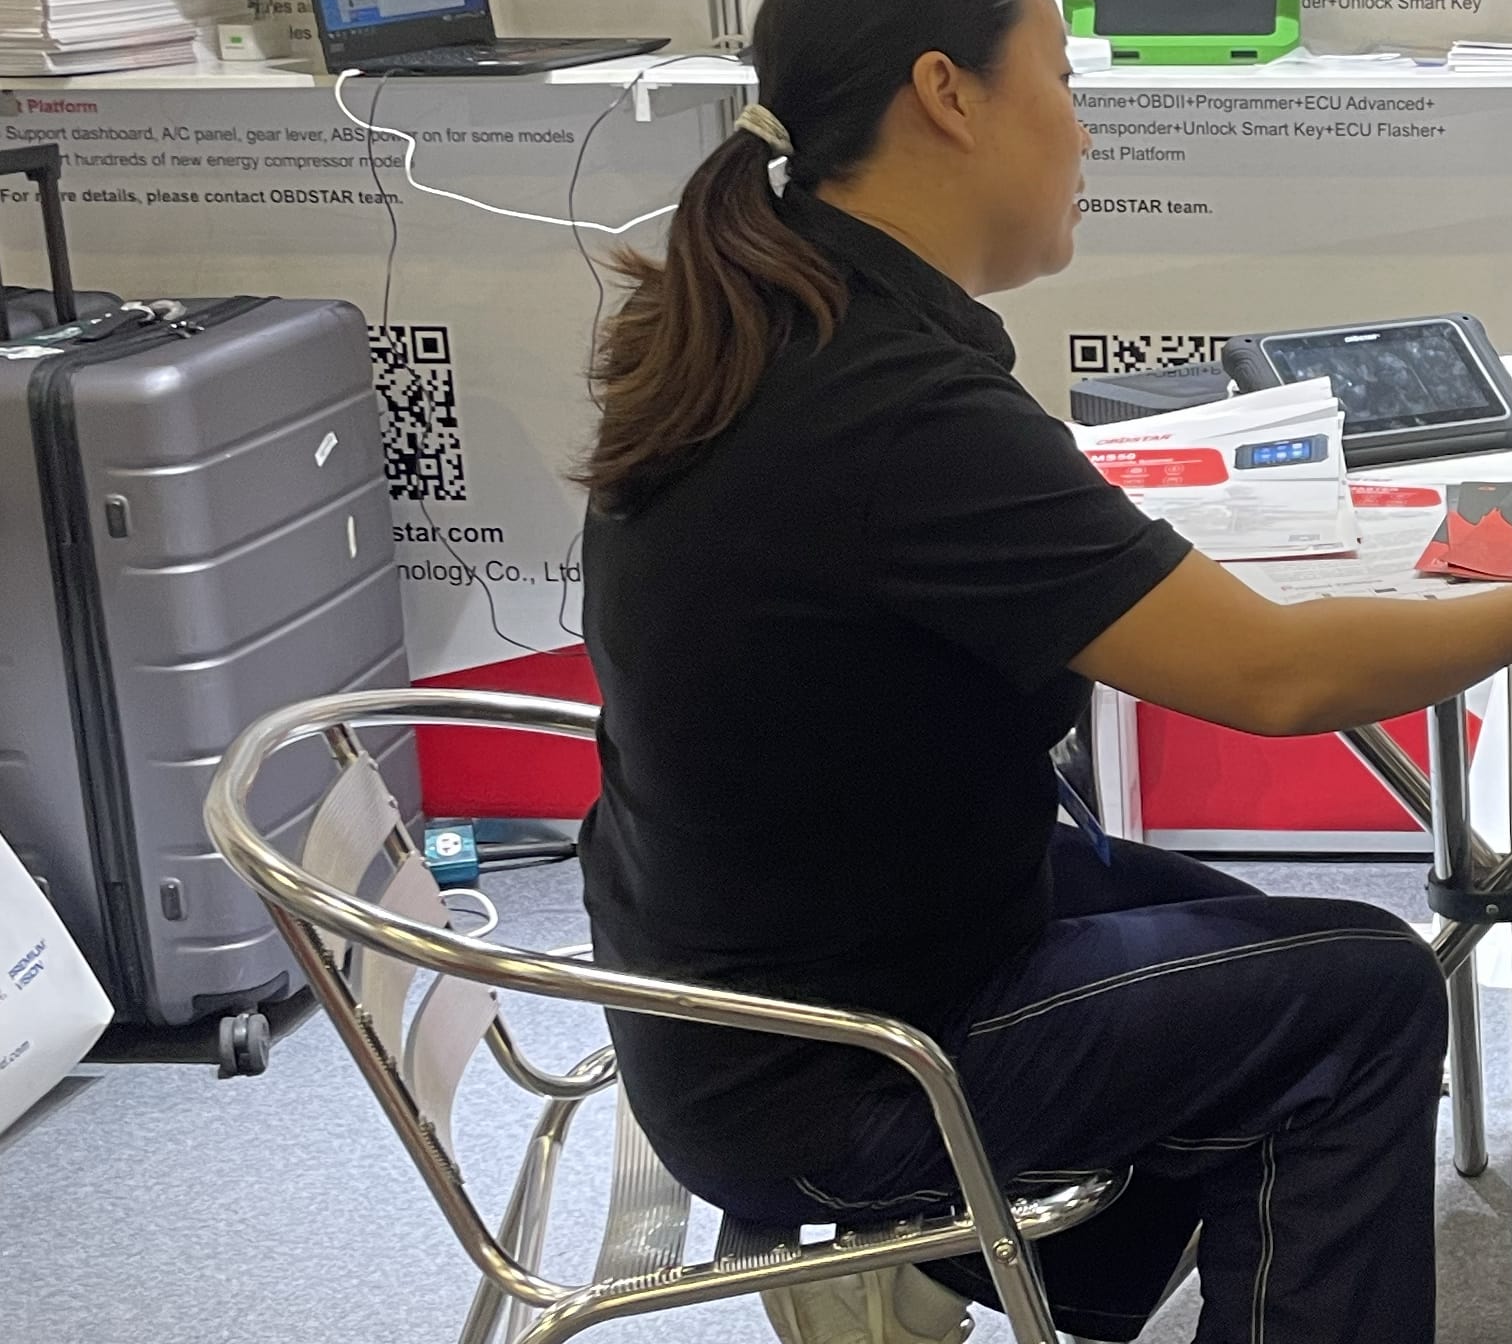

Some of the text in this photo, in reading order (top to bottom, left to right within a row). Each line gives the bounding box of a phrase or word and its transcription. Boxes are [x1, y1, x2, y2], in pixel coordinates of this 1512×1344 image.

[1344, 92, 1436, 112] Advanced+
[5, 124, 68, 145] Support
[70, 124, 158, 145] dashboard,
[161, 124, 191, 142] A/C
[193, 124, 242, 145] panel,
[245, 128, 282, 145] gear
[284, 125, 328, 145] lever,
[330, 125, 367, 142] ABS
[421, 129, 443, 143] on
[445, 125, 468, 143] for
[470, 129, 515, 143] some
[517, 126, 575, 143] models
[1241, 118, 1290, 138] Smart
[1293, 119, 1372, 142] Key+ECU
[1376, 119, 1446, 138] Flasher+
[1119, 142, 1186, 162] Platform
[0, 186, 404, 207] For mre details, please contact OBDSTAR team.
[1076, 194, 1213, 215] OBDSTAR team.
[486, 560, 536, 585] Co.,
[544, 560, 582, 581] Ltd
